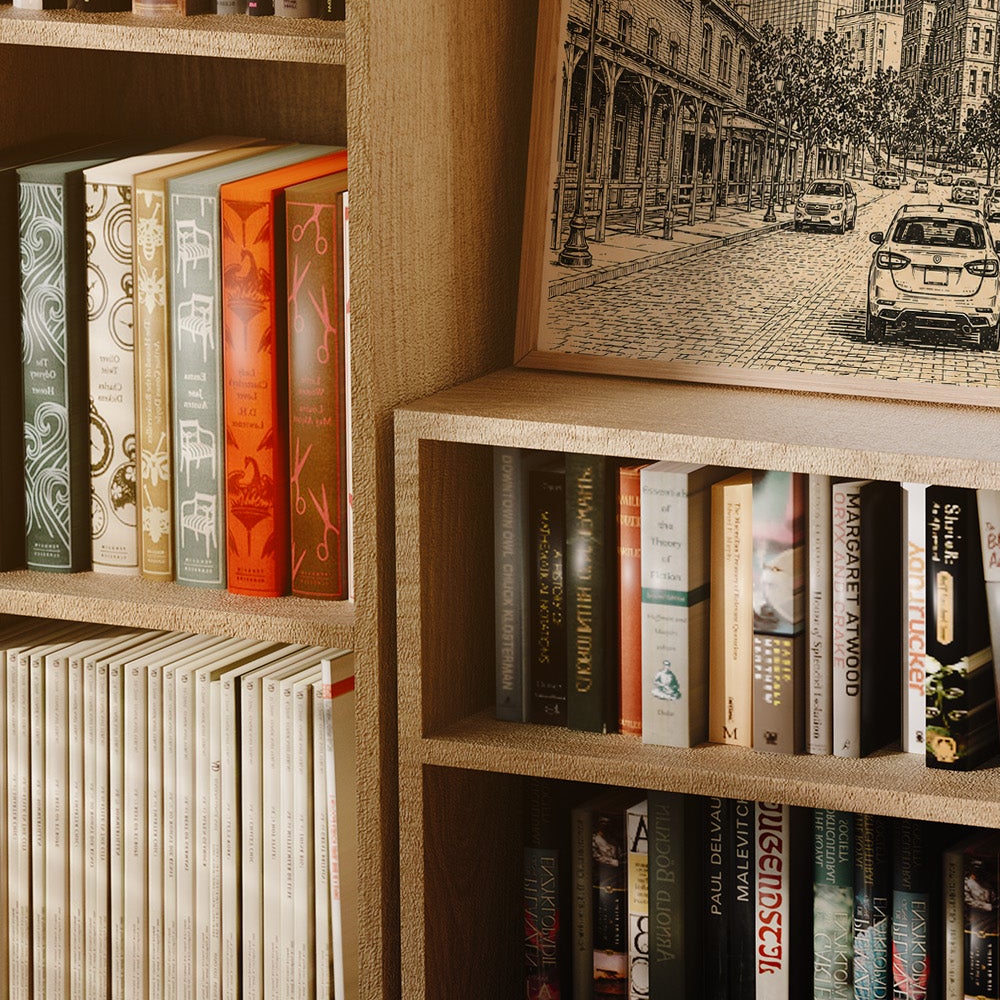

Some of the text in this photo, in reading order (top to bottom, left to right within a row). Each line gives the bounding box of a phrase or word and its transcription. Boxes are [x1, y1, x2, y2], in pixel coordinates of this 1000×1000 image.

[501, 454, 515, 691] DOWNTOWN OWL CHUCK KLOSTERMAN
[833, 491, 846, 669] ORYX AND CRAKE
[845, 492, 861, 698] MARGARET ATWOOD
[722, 726, 739, 741] M
[710, 871, 723, 916] PAUL
